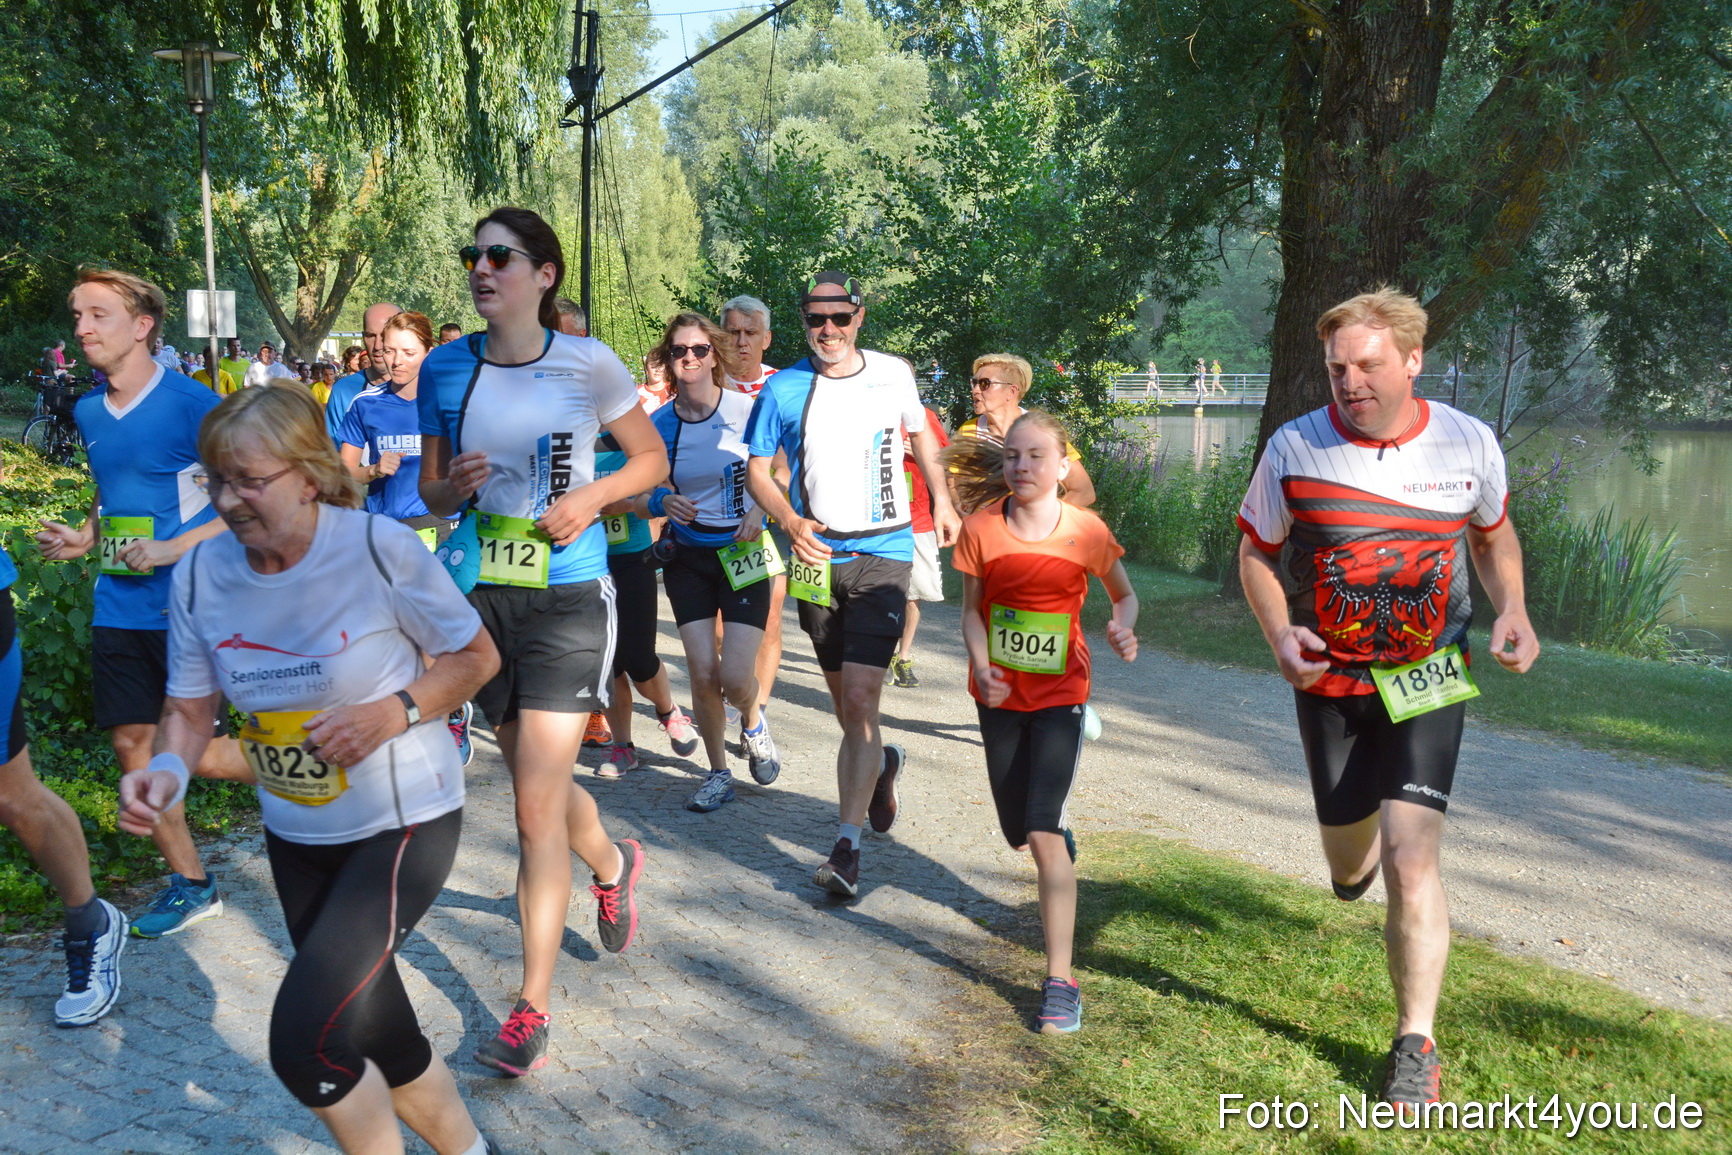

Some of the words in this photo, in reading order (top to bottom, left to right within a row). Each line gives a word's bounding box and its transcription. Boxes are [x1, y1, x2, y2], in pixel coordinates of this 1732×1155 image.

[871, 449, 880, 519] TECHNOLOGY
[881, 428, 897, 521] HUBER
[1403, 481, 1464, 493] NEUMARKT
[731, 548, 773, 576] 2123
[998, 628, 1056, 656] 1904
[231, 661, 322, 684] Seniorenstift
[1391, 656, 1459, 697] 1884
[233, 690, 256, 701] am
[257, 681, 302, 698] Tiroler
[305, 678, 335, 694] Hof
[1405, 690, 1433, 705] Schmid
[250, 743, 329, 779] 1823
